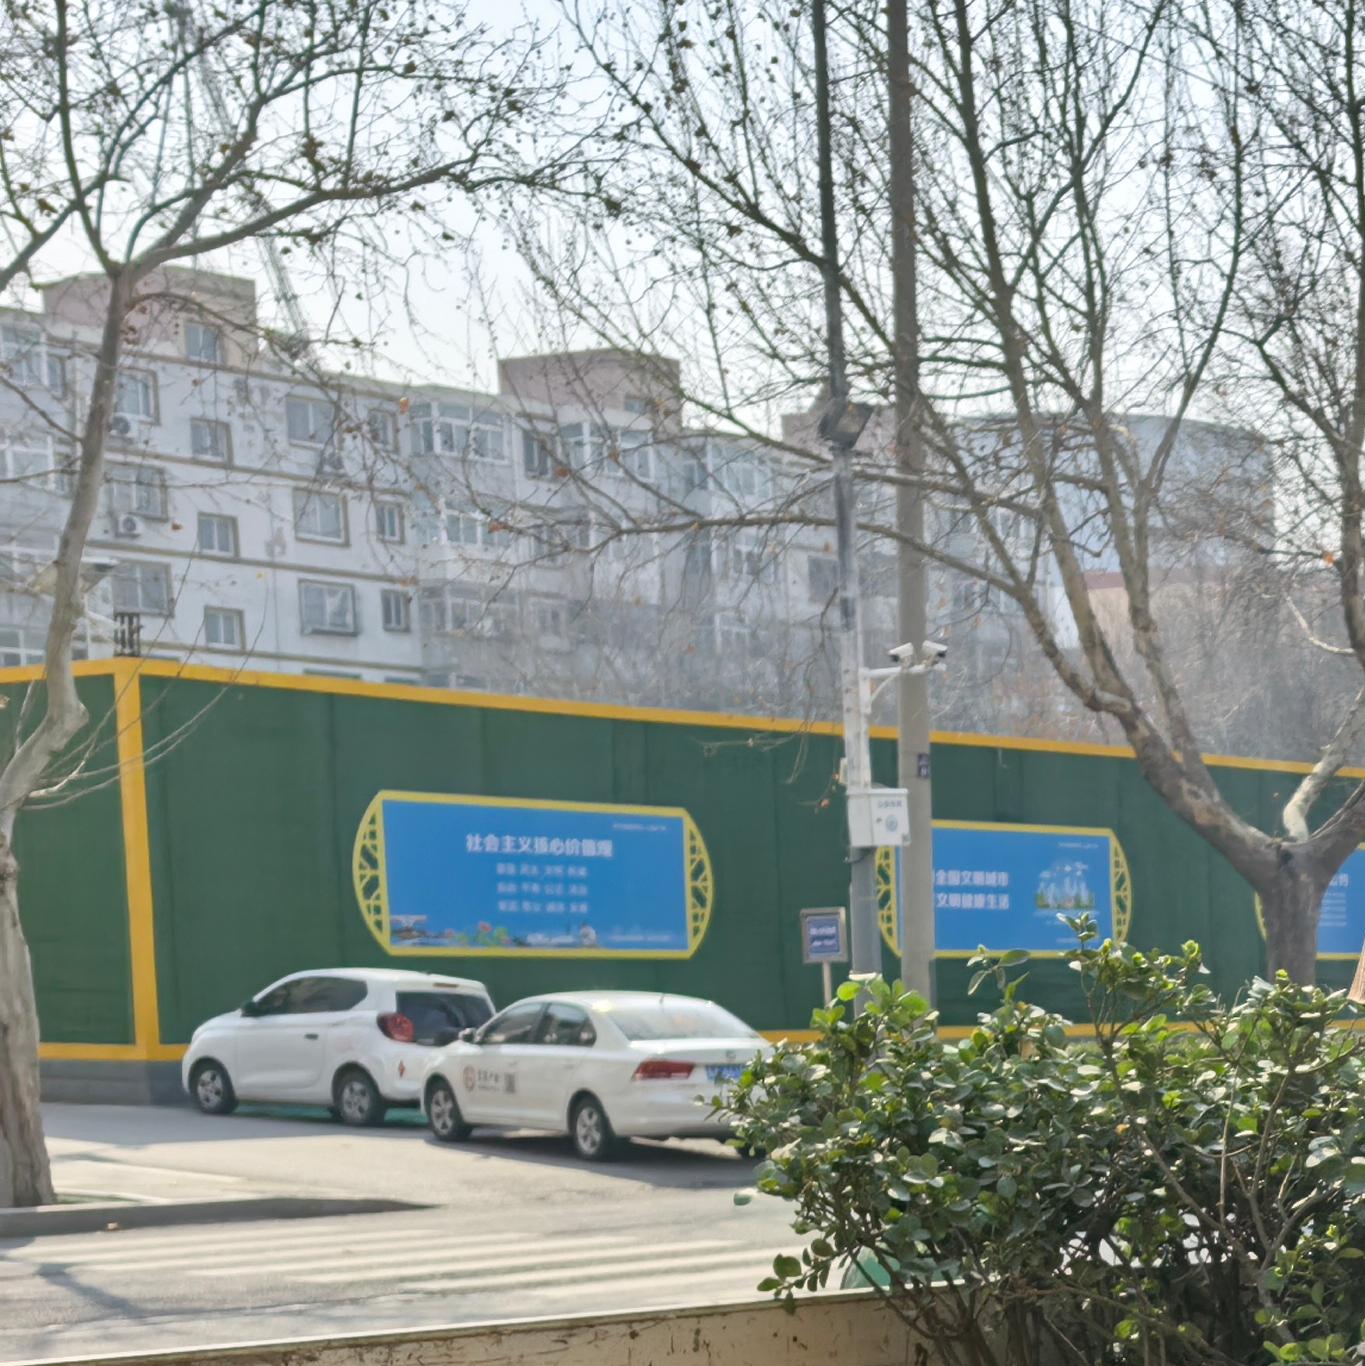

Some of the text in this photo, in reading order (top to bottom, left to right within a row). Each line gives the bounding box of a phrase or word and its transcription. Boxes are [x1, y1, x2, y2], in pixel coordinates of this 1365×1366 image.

[934, 869, 1009, 886] 全国文明城市
